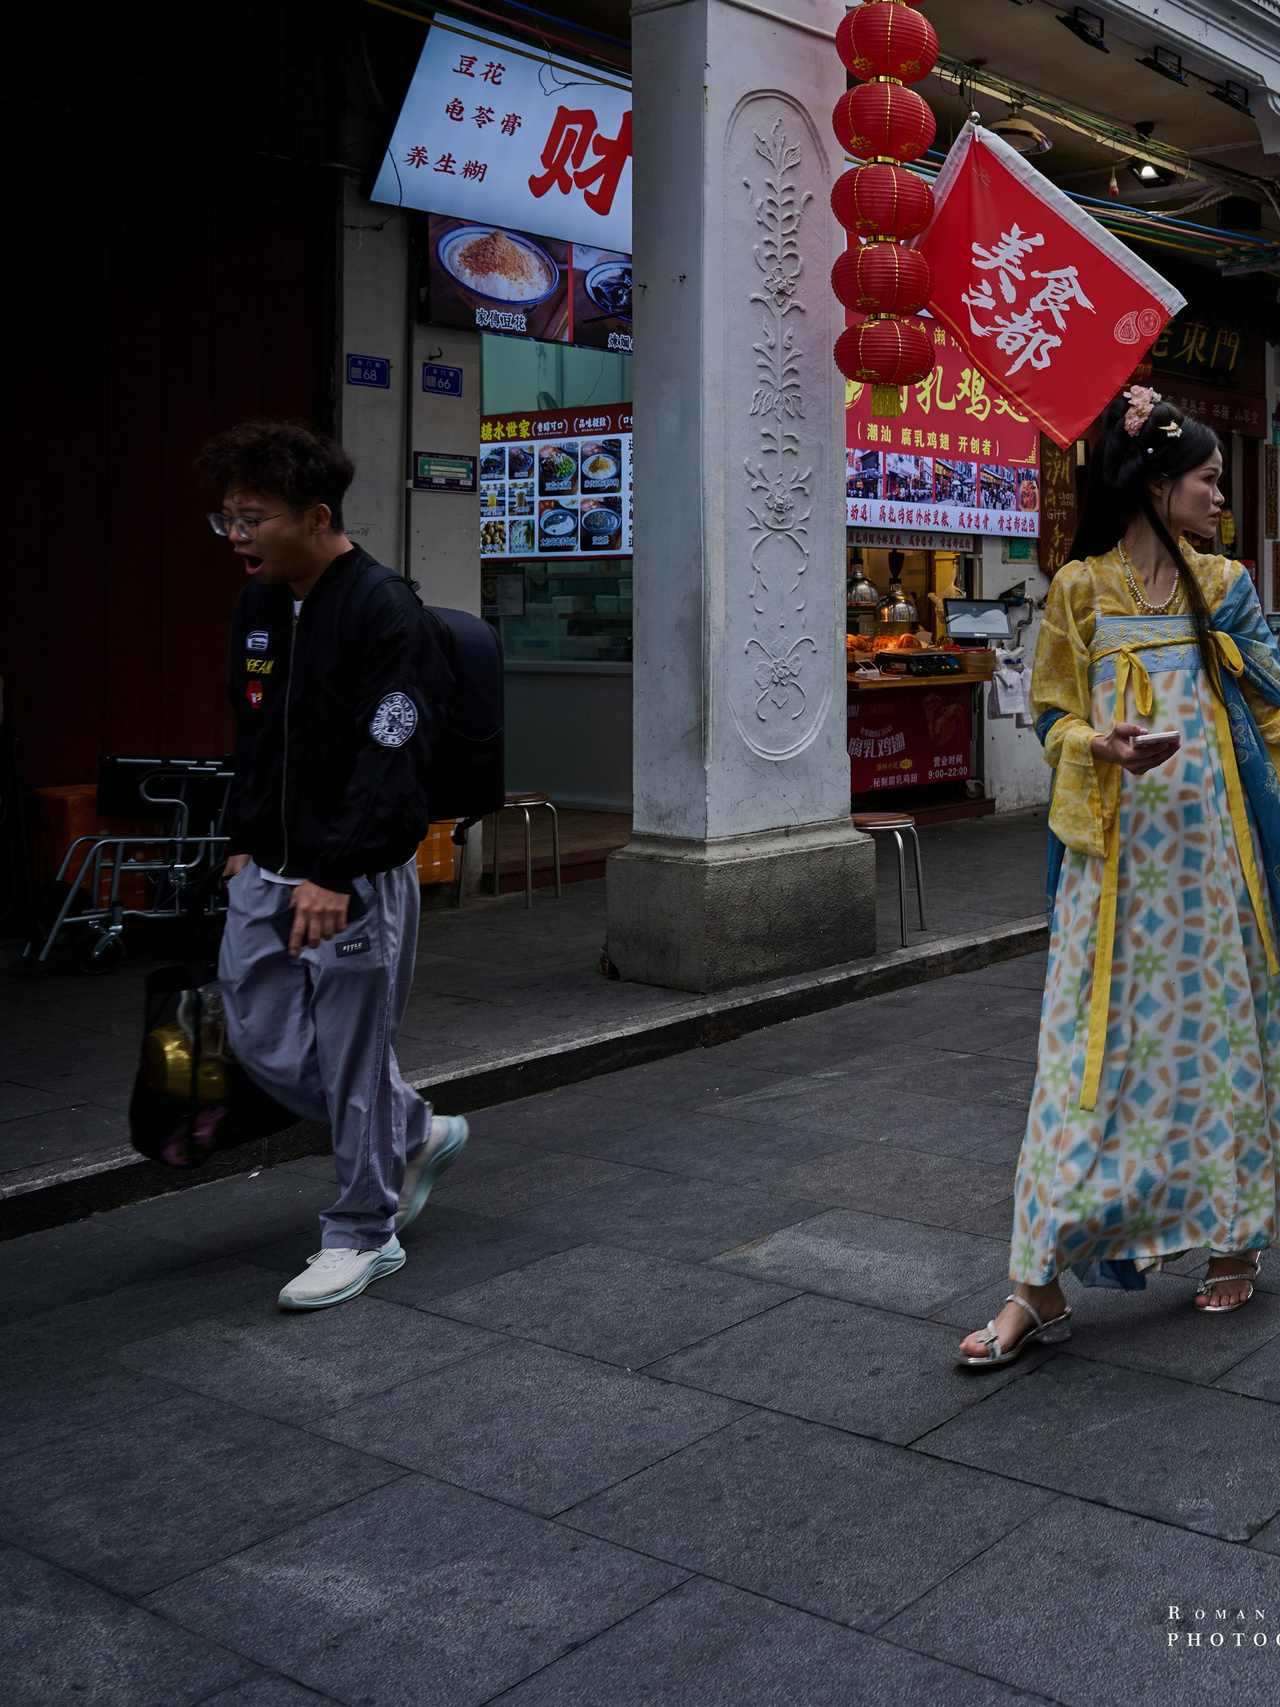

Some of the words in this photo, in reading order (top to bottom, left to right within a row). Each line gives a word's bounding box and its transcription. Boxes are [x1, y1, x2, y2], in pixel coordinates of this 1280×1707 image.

[452, 54, 506, 86] 豆花
[445, 98, 522, 137] 龟苓膏
[402, 145, 488, 184] 养生糊
[528, 105, 632, 216] 财
[363, 369, 377, 381] 68
[437, 377, 451, 390] 66
[901, 428, 950, 451] 腐乳鸡翅
[1047, 508, 1067, 521] Gift
[848, 731, 906, 758] 腐乳鸡翅
[933, 754, 963, 768] 营业时间
[873, 773, 918, 788] 秘制腐乳鸡翅
[928, 766, 968, 780] 9:00-22:00
